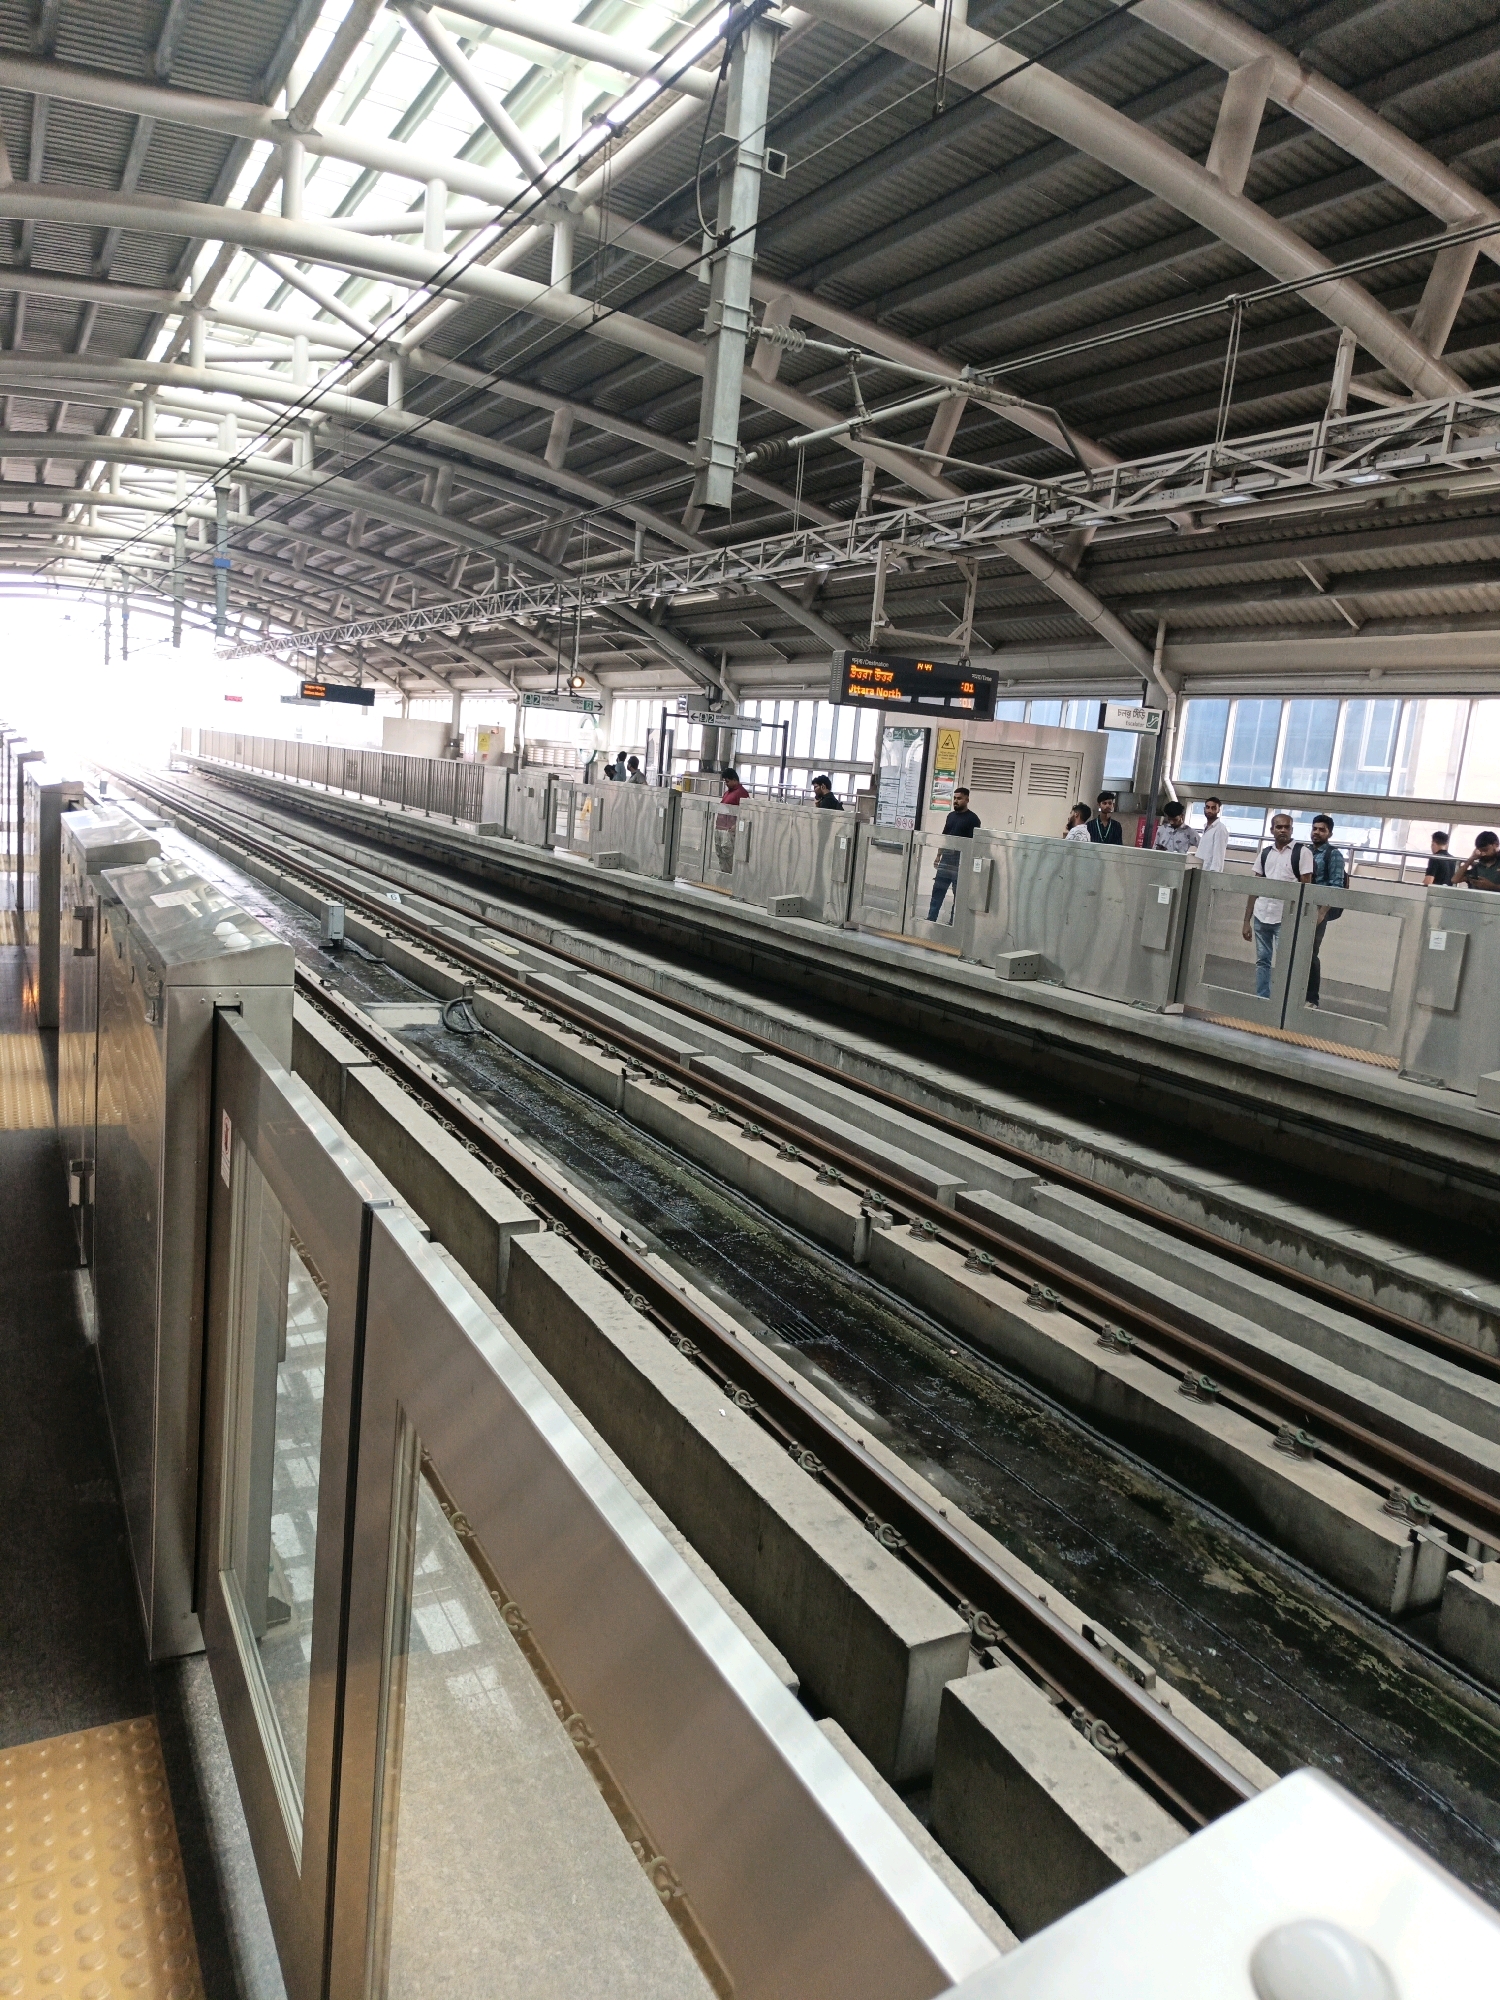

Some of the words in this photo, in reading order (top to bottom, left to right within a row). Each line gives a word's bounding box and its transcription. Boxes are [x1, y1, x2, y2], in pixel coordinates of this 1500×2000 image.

[876, 687, 902, 699] North
[533, 695, 540, 705] 2
[708, 714, 714, 723] 2
